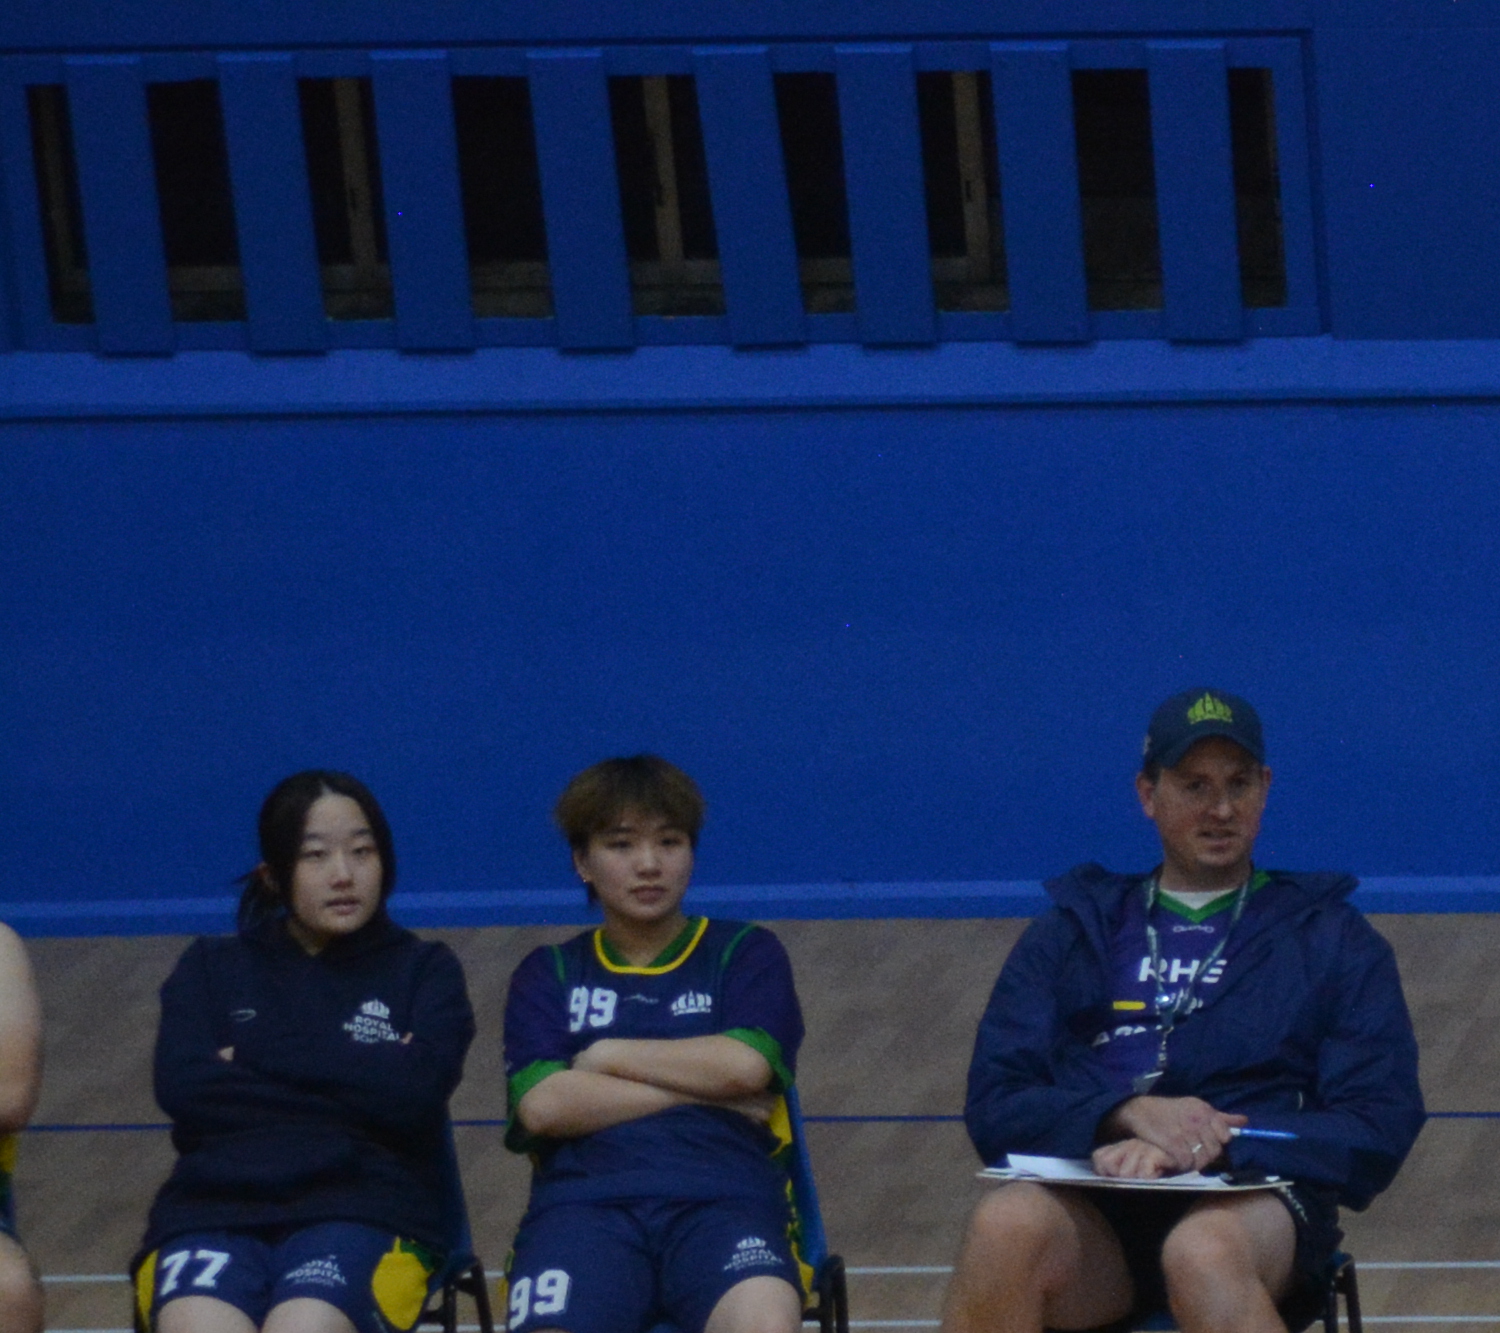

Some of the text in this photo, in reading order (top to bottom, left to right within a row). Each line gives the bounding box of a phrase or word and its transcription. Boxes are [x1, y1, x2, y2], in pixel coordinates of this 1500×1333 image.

[568, 985, 619, 1034] 99
[160, 1249, 231, 1298] 77
[508, 1268, 573, 1331] 99
